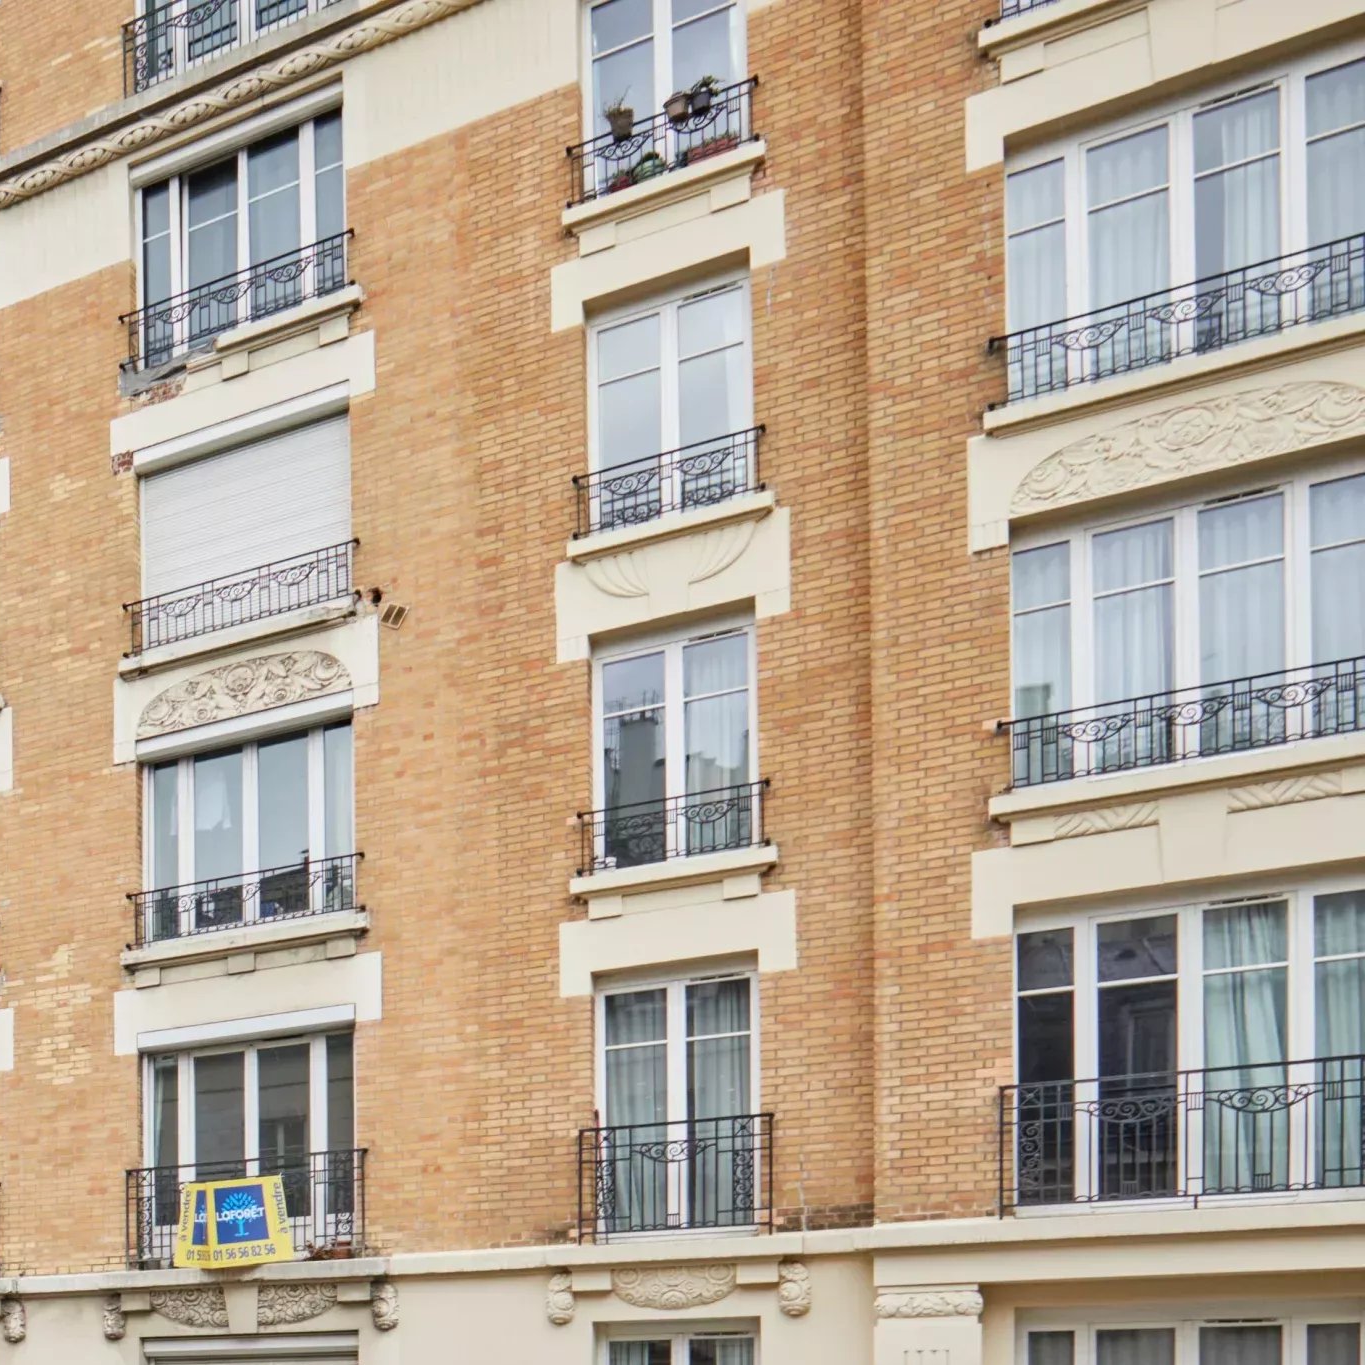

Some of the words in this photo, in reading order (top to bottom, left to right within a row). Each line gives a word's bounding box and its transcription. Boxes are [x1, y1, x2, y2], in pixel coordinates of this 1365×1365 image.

[213, 1249, 223, 1261] 01
[225, 1248, 237, 1260] 56
[238, 1247, 249, 1259] 56
[264, 1244, 276, 1256] 56
